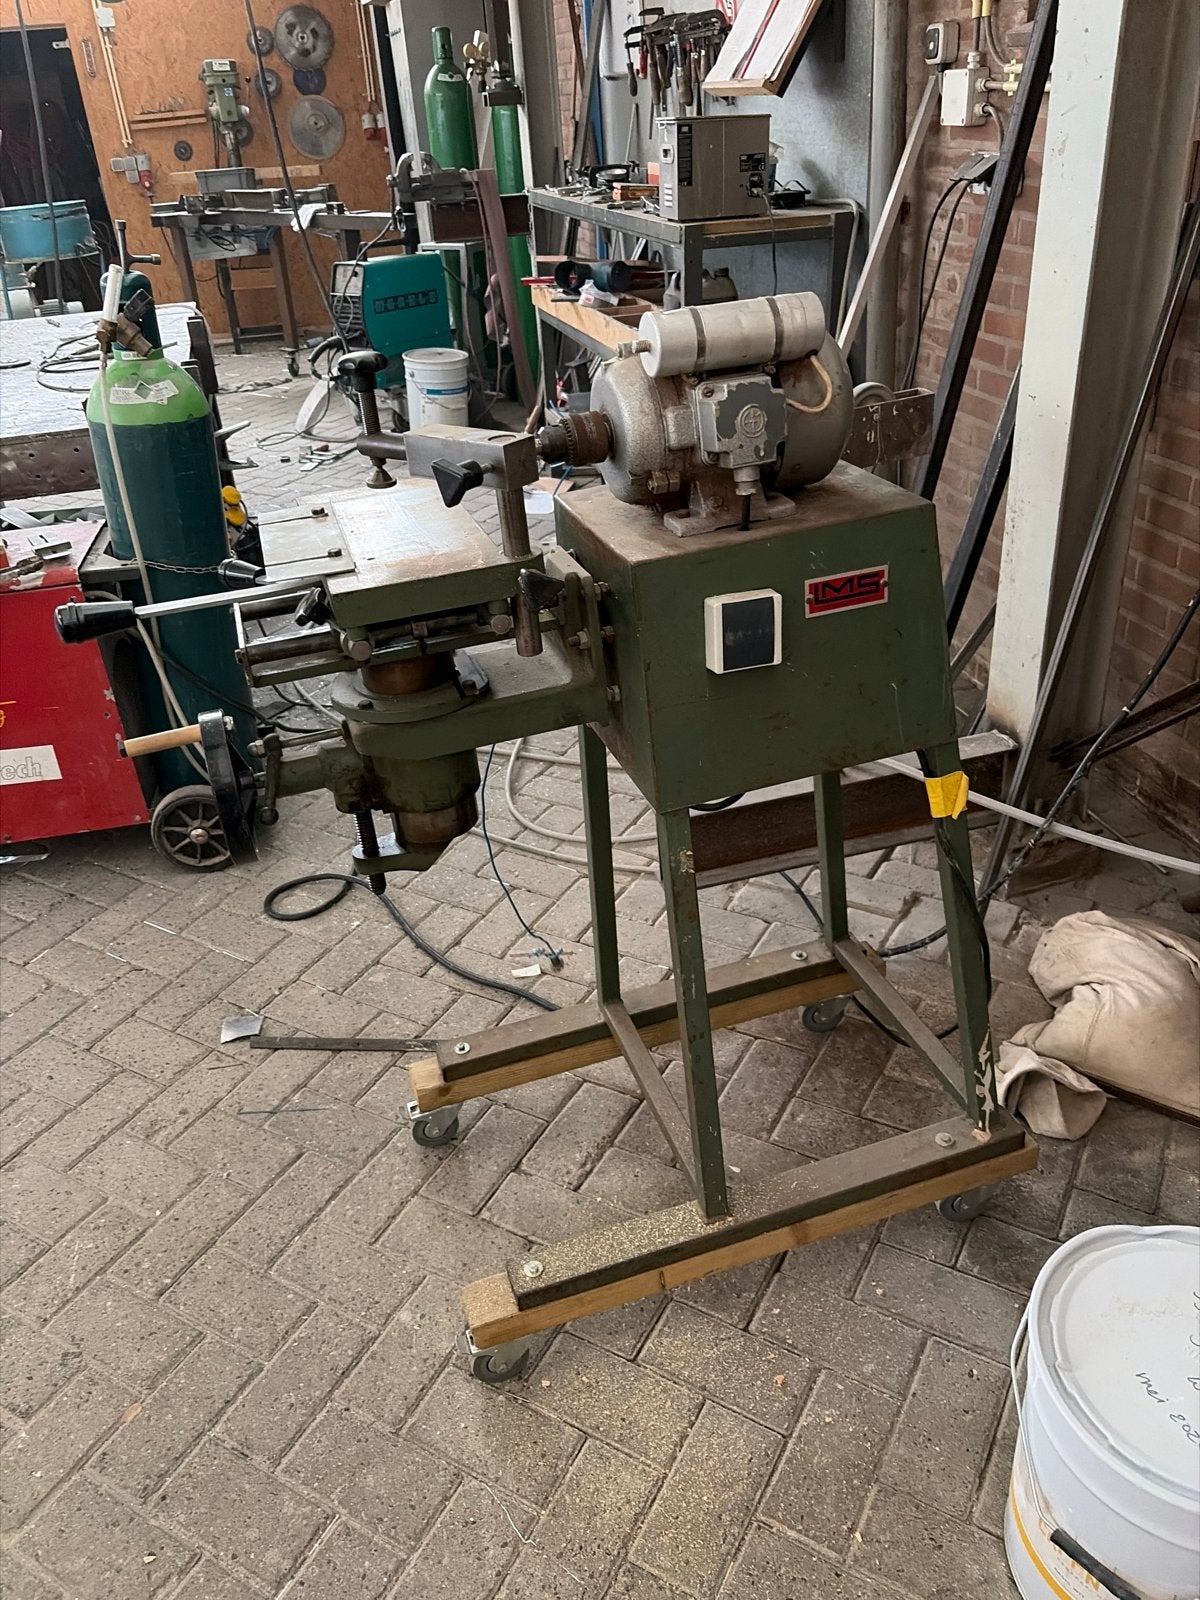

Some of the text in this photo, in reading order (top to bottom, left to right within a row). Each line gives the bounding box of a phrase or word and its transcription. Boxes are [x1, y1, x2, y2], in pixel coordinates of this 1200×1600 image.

[813, 569, 880, 605] LMS
[0, 756, 42, 780] ech
[1135, 1372, 1200, 1448] mei 202
